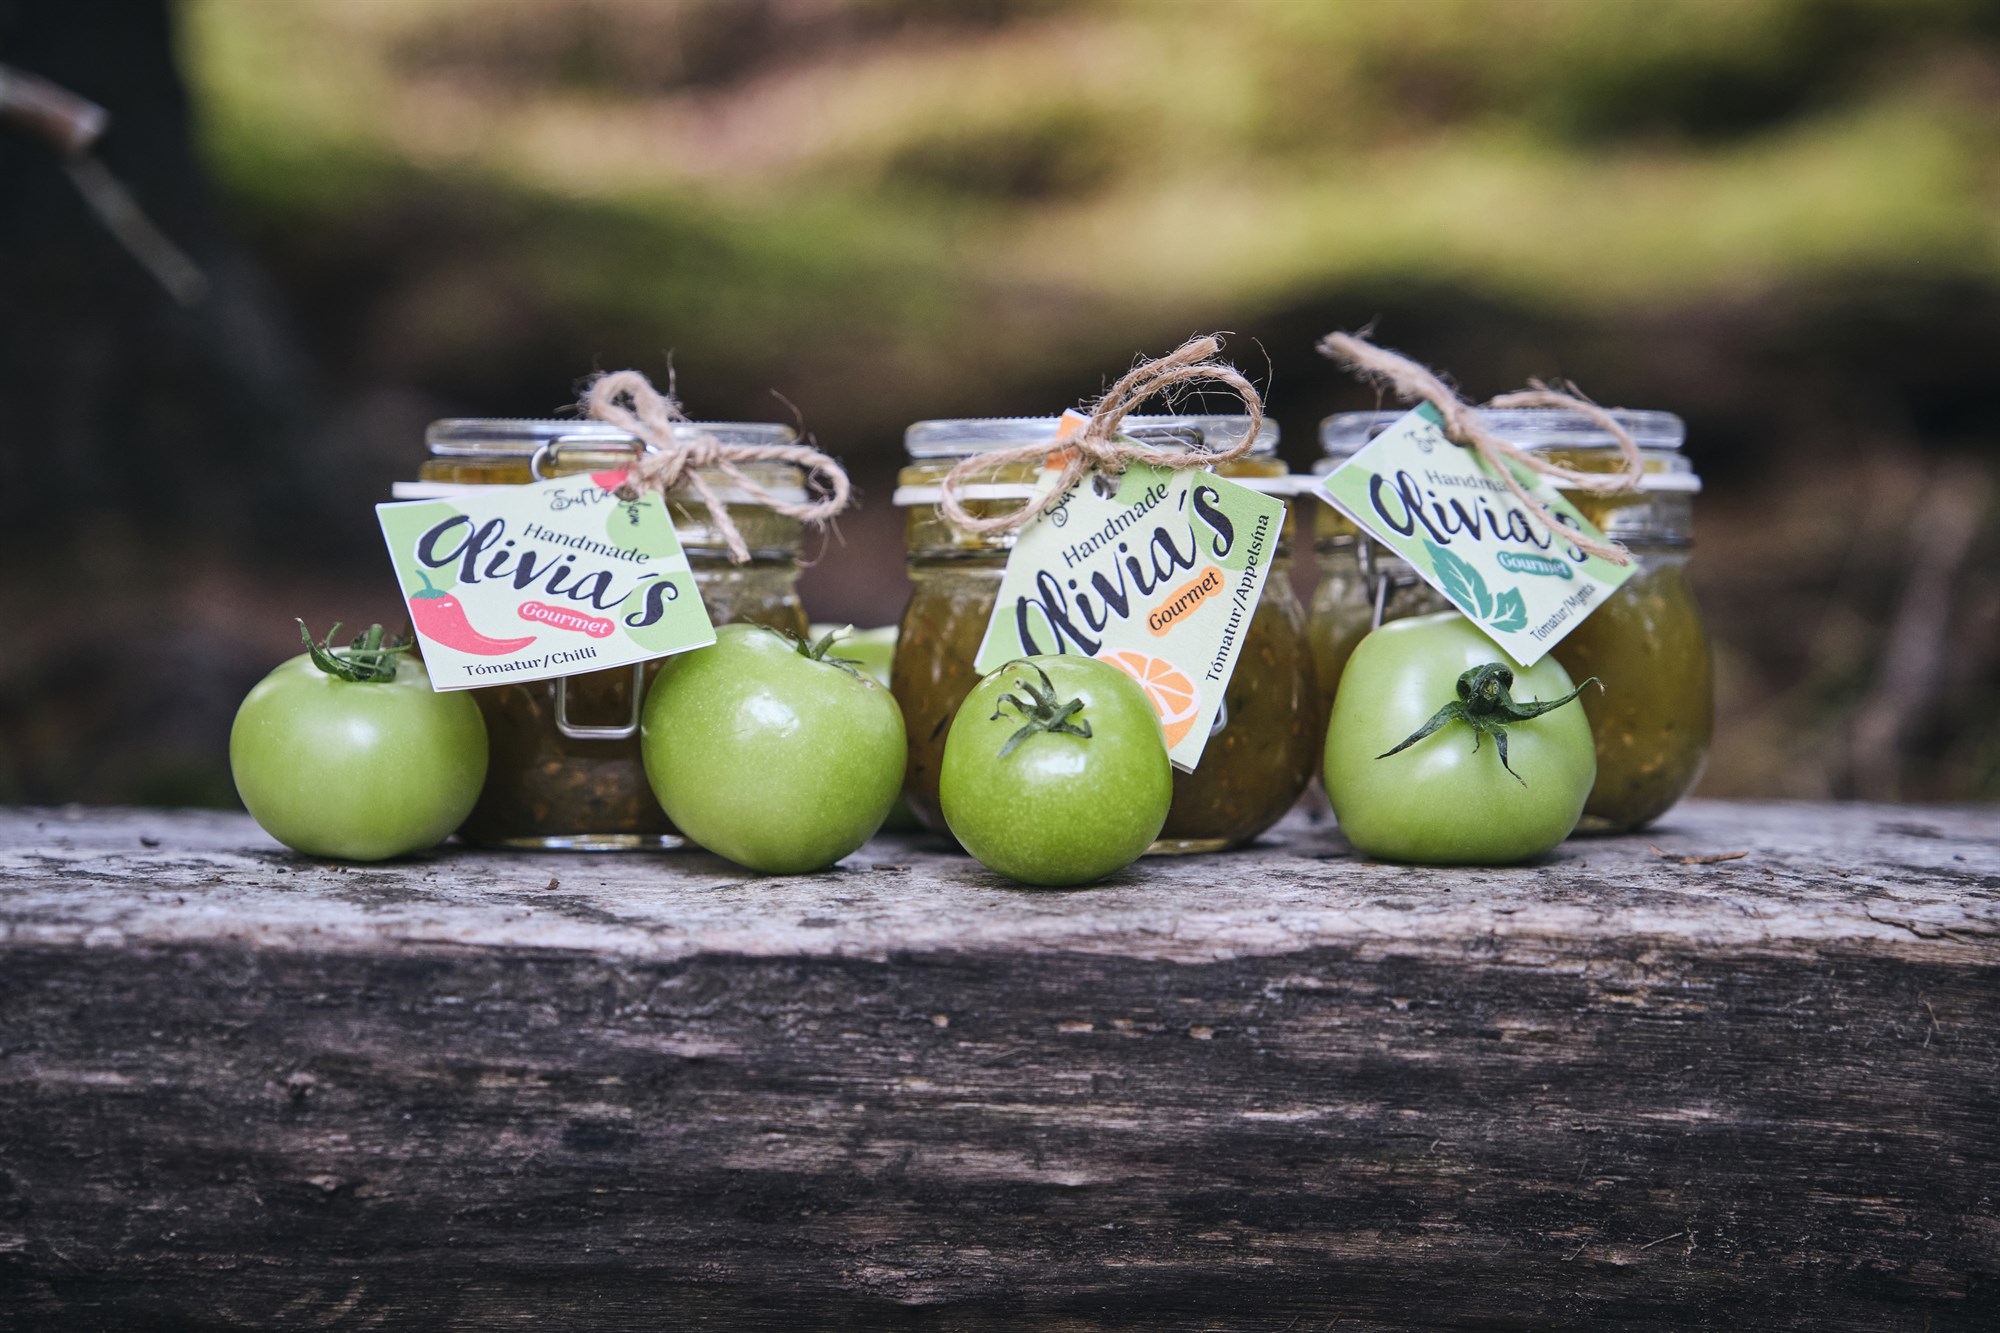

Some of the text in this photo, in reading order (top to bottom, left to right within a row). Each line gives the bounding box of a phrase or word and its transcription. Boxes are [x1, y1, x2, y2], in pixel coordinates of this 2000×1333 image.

[523, 522, 650, 565] Handmade
[1062, 481, 1169, 568] Handmade
[1500, 552, 1569, 575] Gourmet
[521, 603, 610, 634] Gourmet
[1149, 571, 1220, 632] Gourmet
[1205, 514, 1270, 682] Tómatur/Appelsína
[463, 647, 597, 676] Tómatur/Chilli
